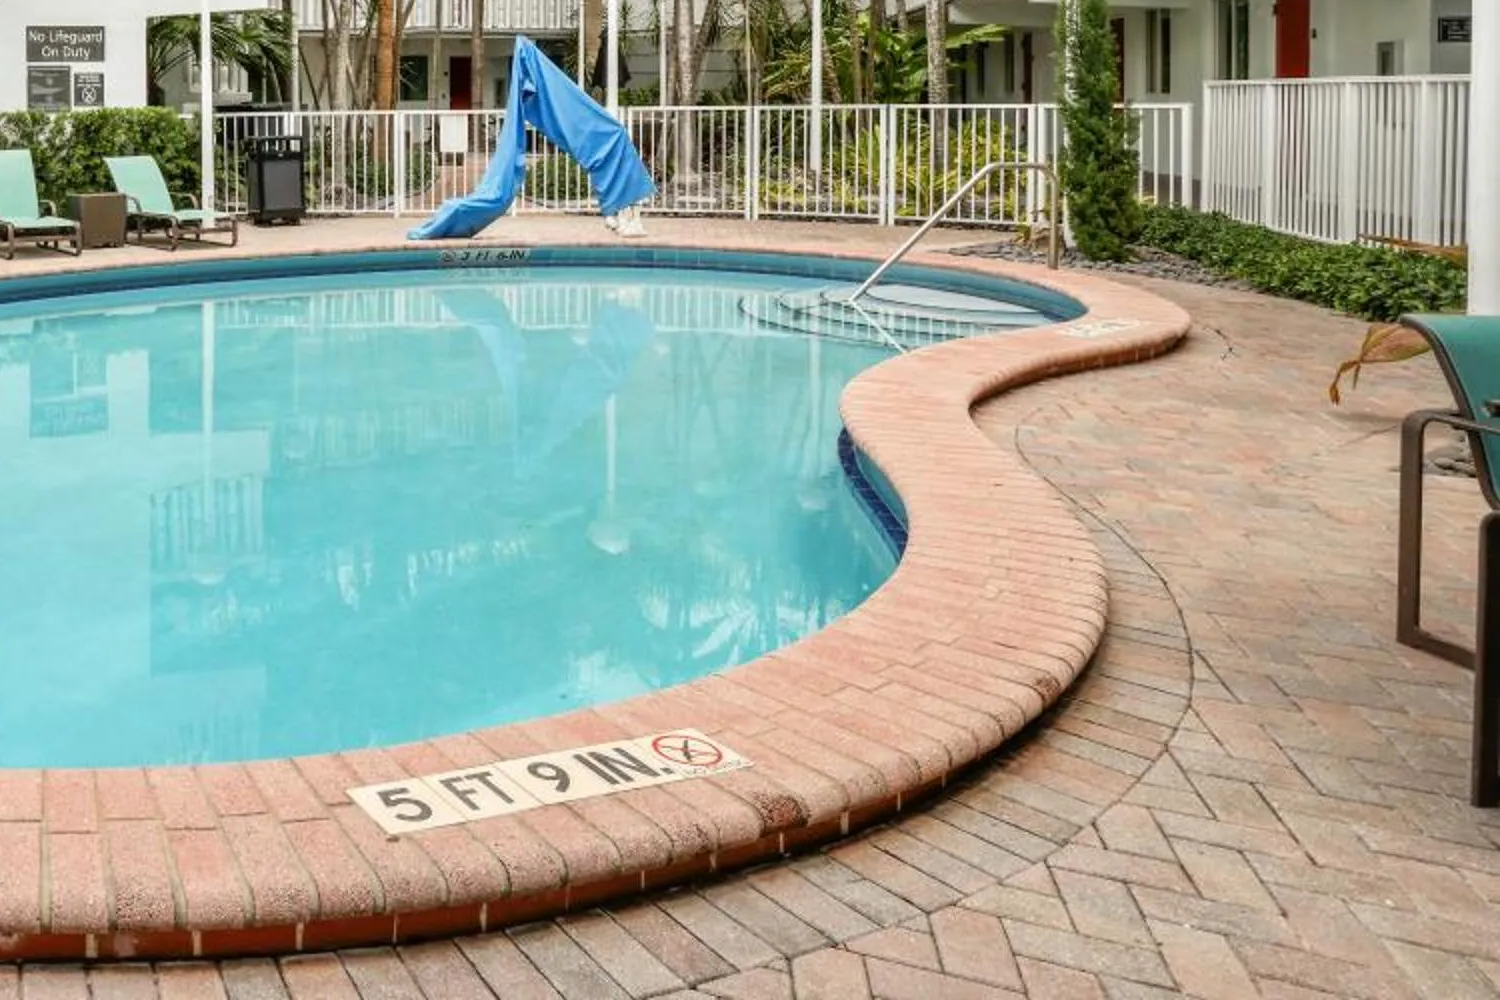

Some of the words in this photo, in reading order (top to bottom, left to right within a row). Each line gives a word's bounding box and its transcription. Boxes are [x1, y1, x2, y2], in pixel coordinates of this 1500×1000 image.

[29, 29, 45, 42] No
[49, 29, 103, 45] Lifeguard
[41, 46, 59, 57] On
[63, 45, 91, 60] Duty
[376, 786, 433, 822] 5
[439, 770, 515, 811] FT
[526, 760, 571, 793] 9
